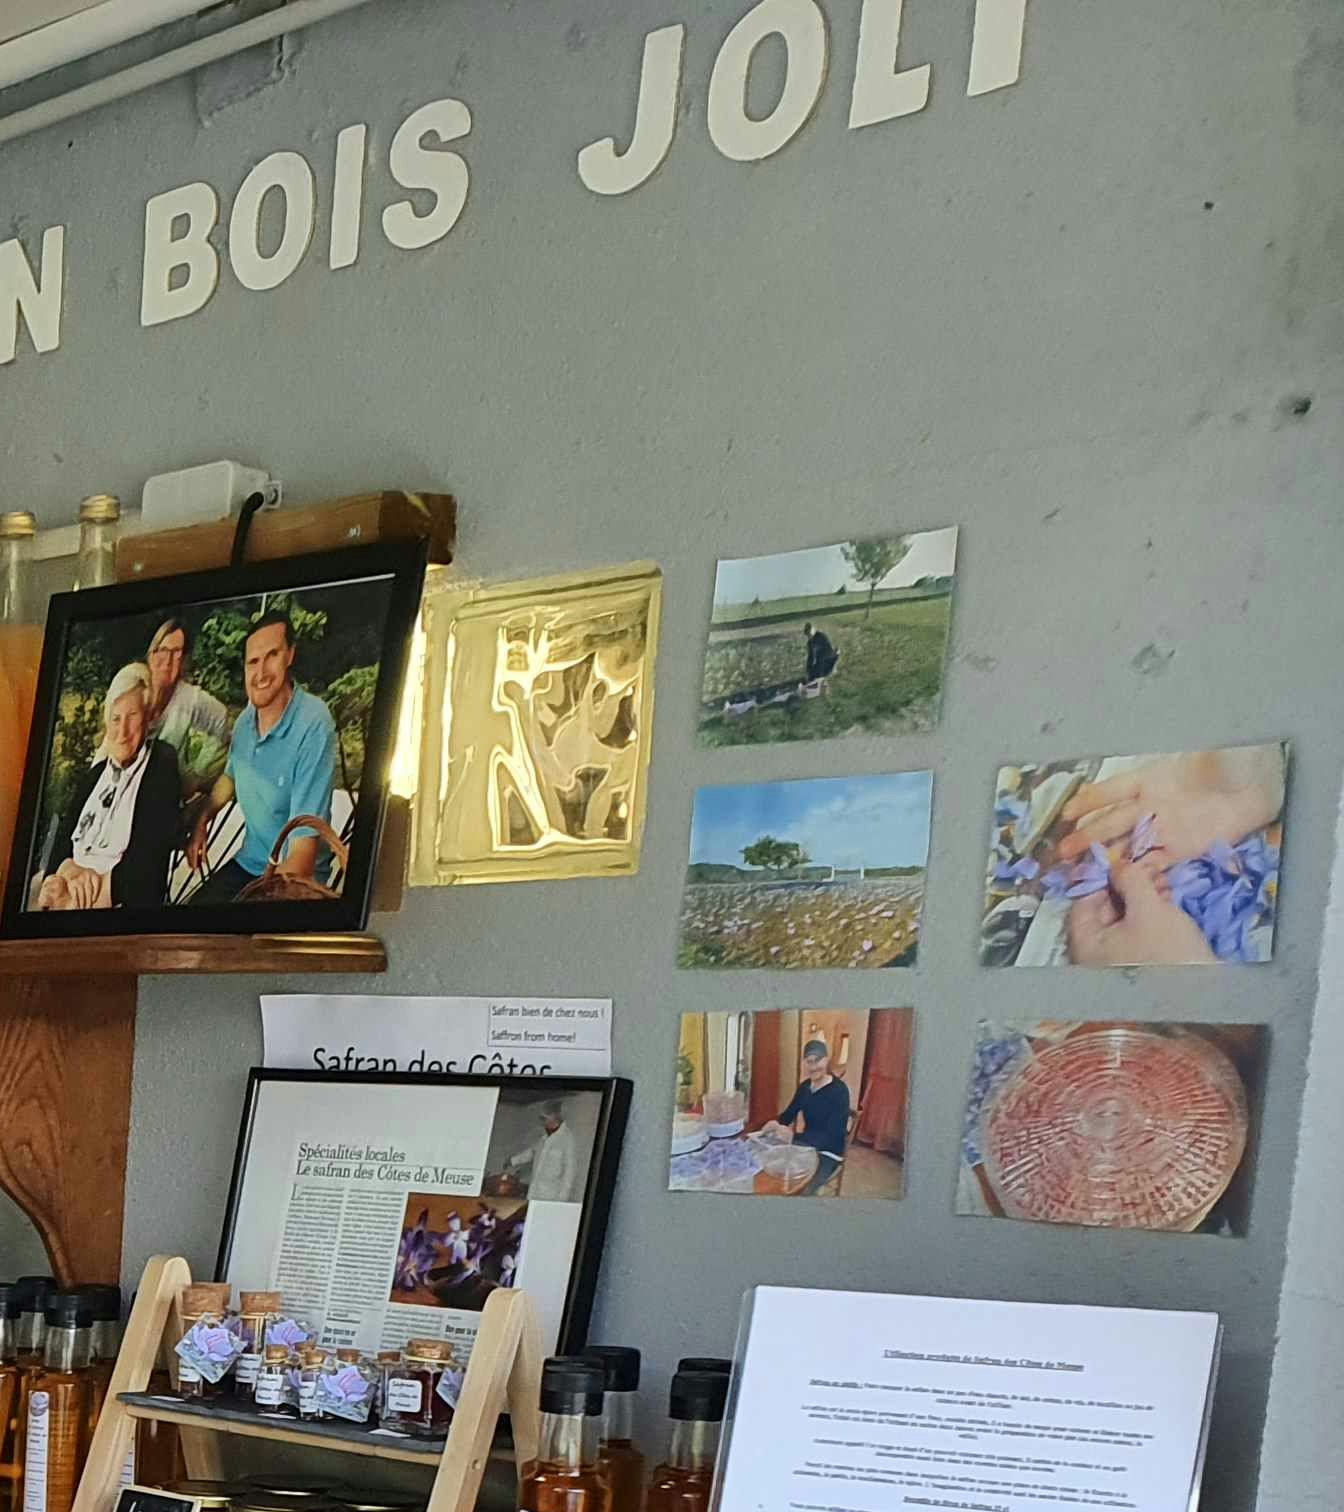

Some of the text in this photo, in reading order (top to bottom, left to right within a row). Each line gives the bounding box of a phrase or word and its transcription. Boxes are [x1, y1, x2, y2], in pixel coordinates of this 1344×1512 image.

[140, 98, 472, 327] BOIS
[578, 0, 1028, 196] JOLI
[491, 1006, 520, 1017] Safran
[521, 1006, 540, 1017] bien
[543, 1006, 553, 1017] de
[555, 1007, 575, 1018] chez
[578, 1009, 599, 1018] nous
[491, 1030, 521, 1041] Saffron
[524, 1030, 545, 1041] from
[313, 1046, 397, 1072] Safran
[408, 1050, 457, 1074] des
[299, 1142, 406, 1162] Spécialités locales
[296, 1160, 475, 1186] Le safran des Côtes de Meuse
